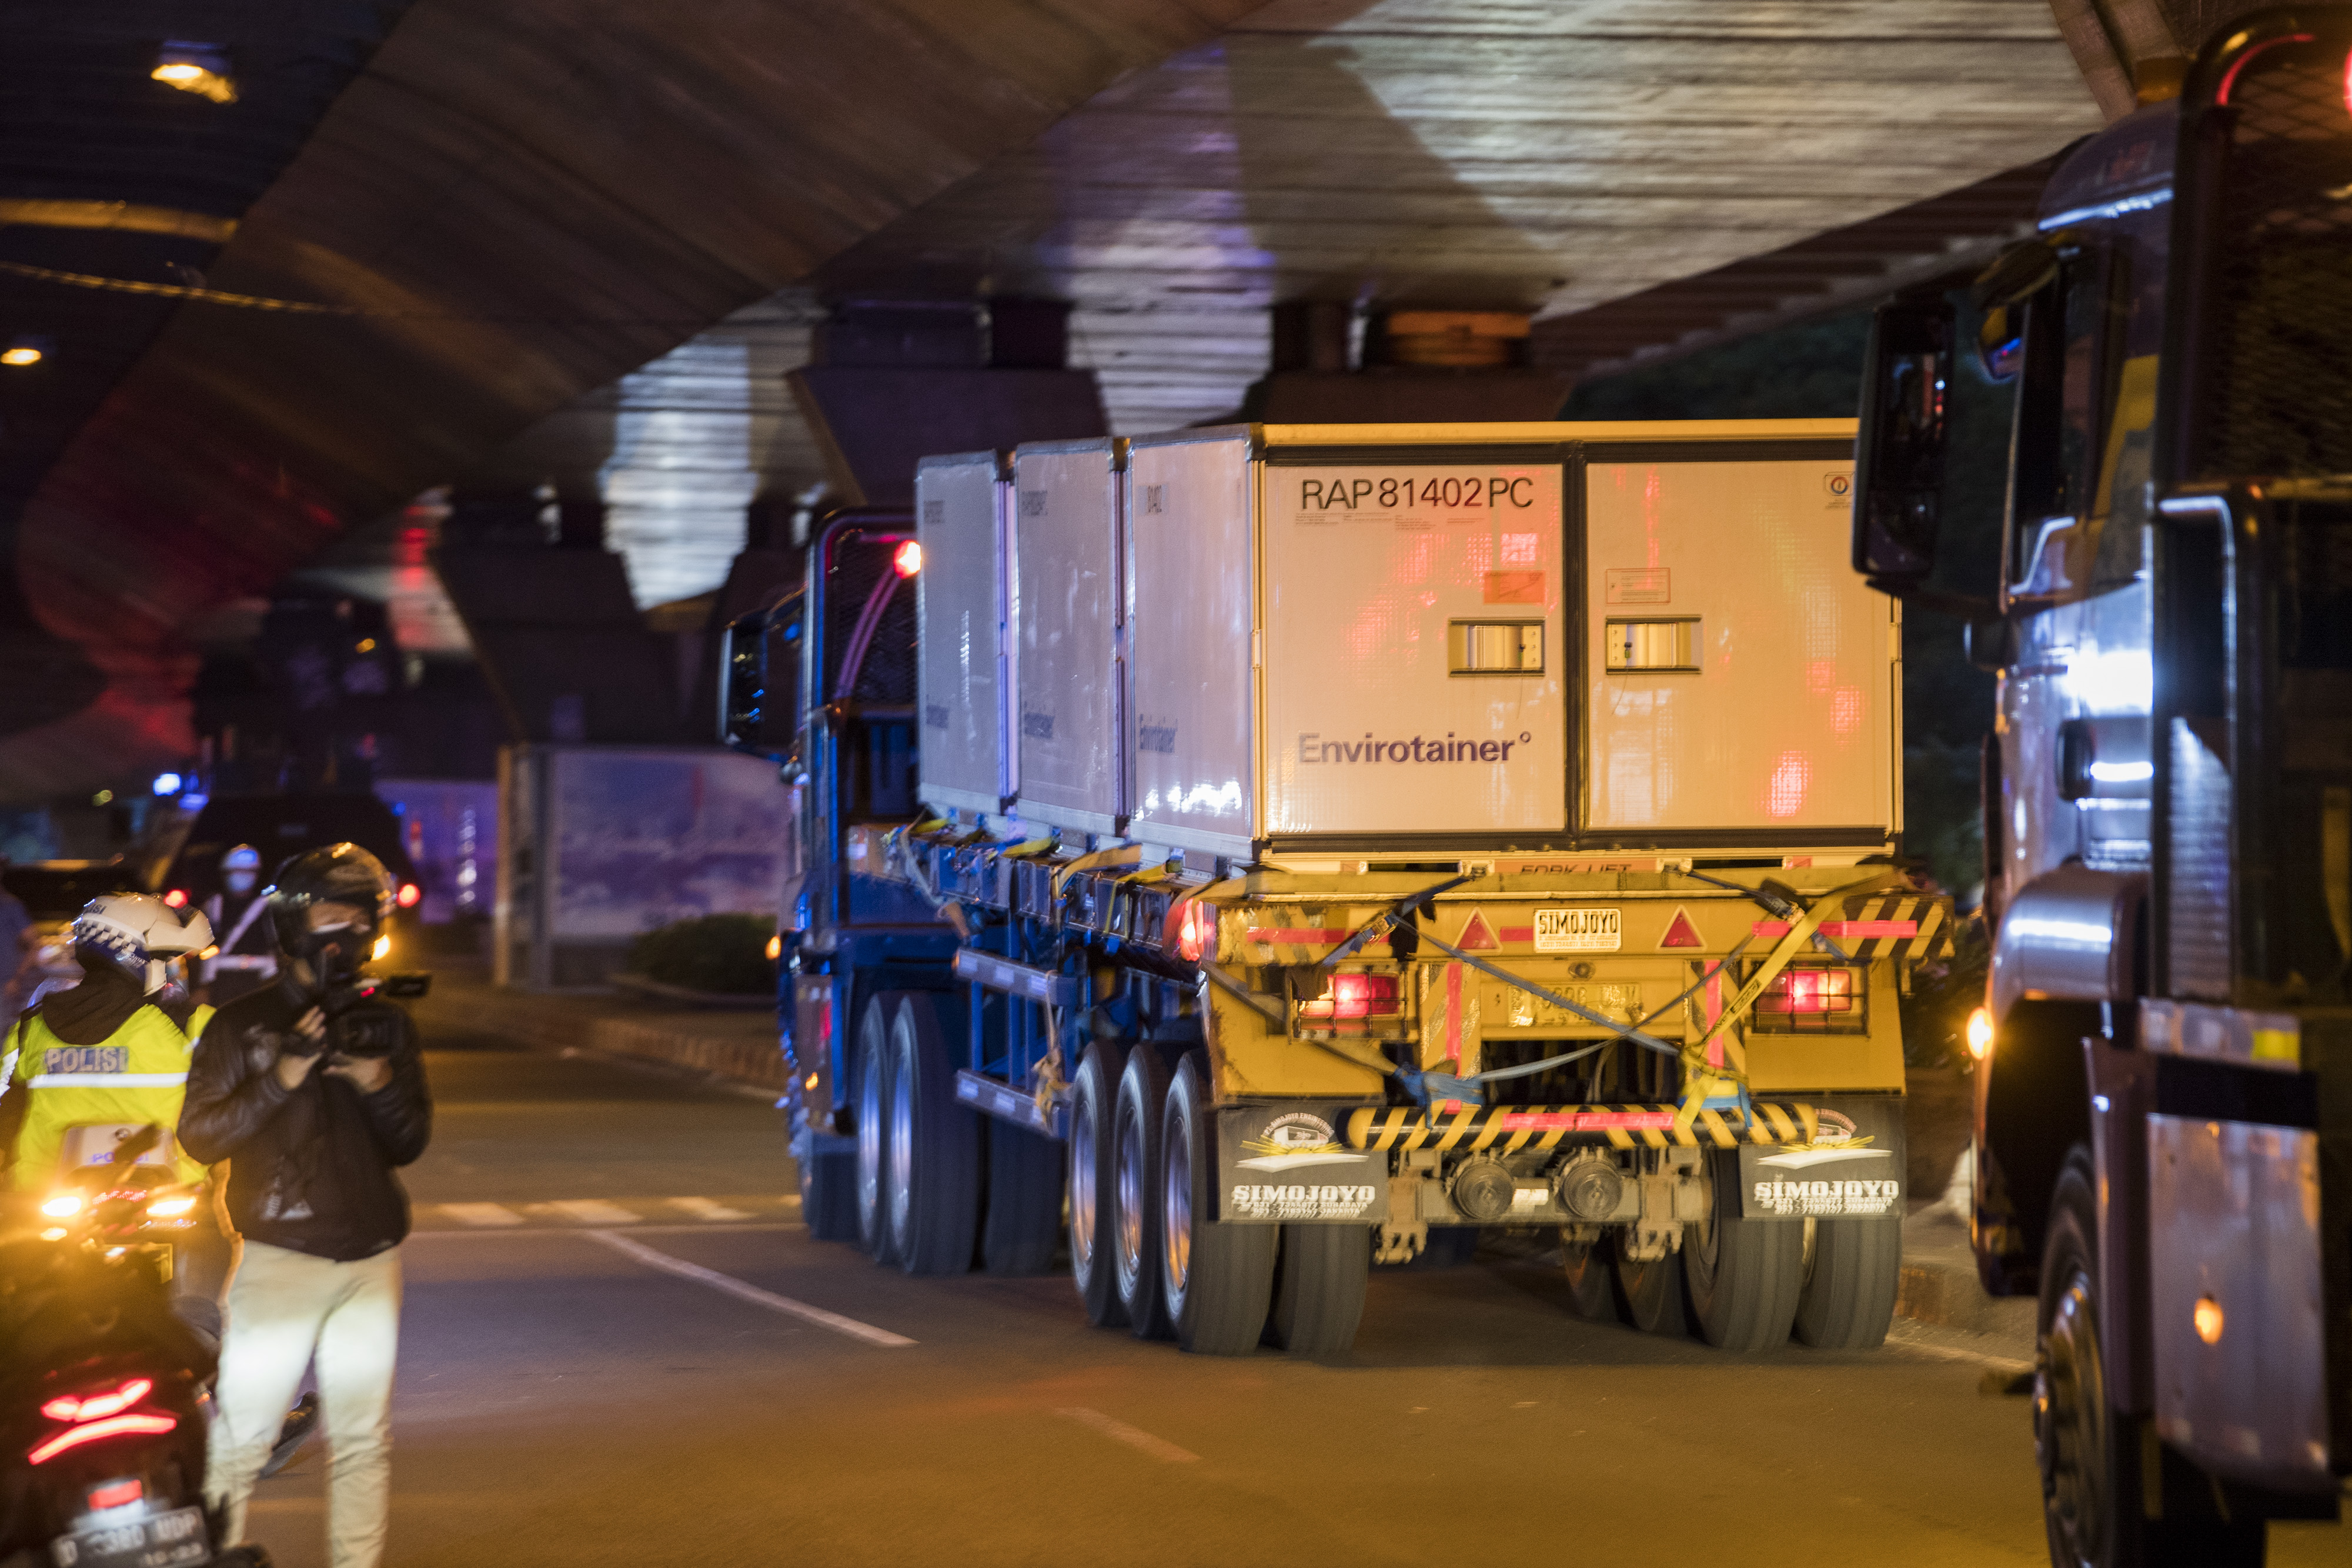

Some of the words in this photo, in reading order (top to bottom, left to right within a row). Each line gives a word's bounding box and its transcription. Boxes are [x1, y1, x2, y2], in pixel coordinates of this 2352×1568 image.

[1539, 911, 1618, 934] SIMOJOYO
[47, 1046, 127, 1072] POLISI
[1232, 1185, 1375, 1203] SIMOJOYO
[1755, 1181, 1899, 1199] SIMOJOYO
